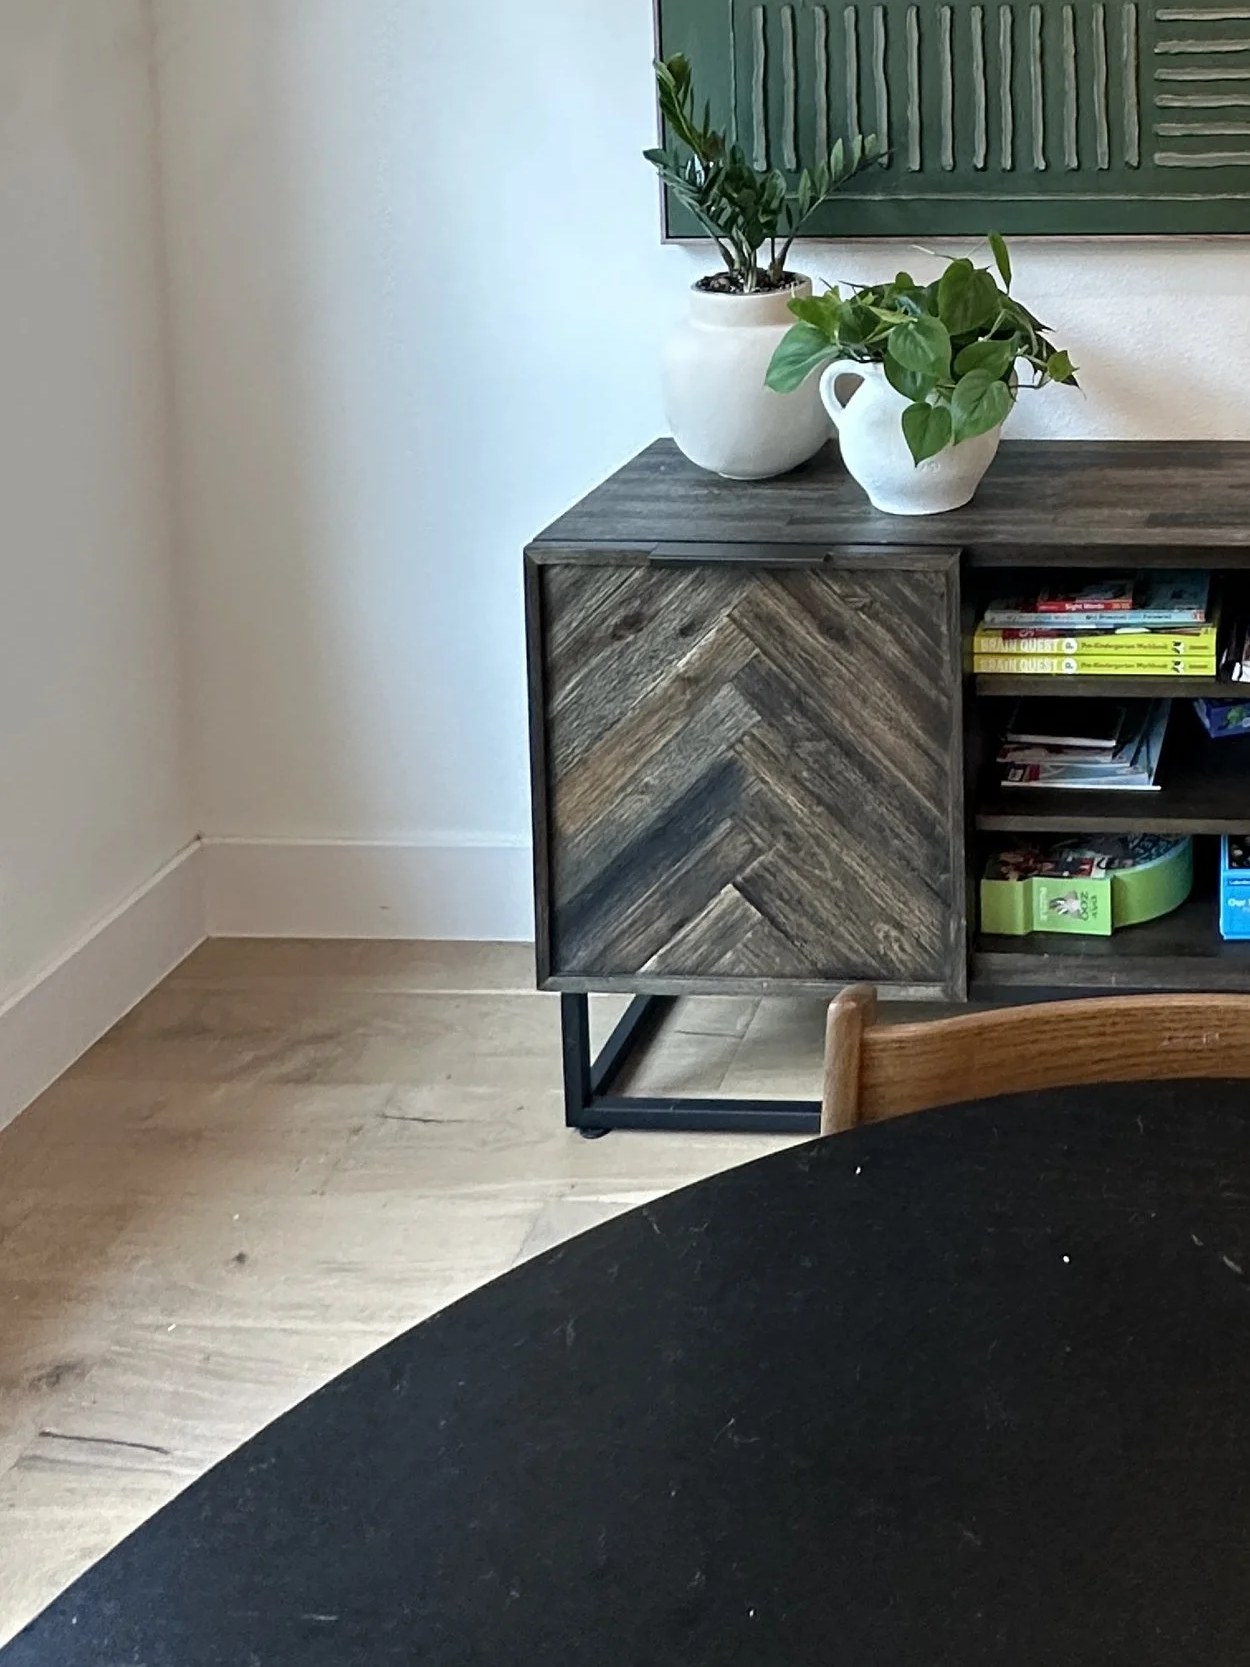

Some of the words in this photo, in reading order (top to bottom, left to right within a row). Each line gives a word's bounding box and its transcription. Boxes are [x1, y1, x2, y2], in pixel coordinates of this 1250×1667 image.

[982, 637, 1017, 653] BRAIN
[1020, 638, 1057, 653] QUEST
[982, 657, 1017, 672] BRAIN
[1020, 657, 1056, 672] QUEST
[1227, 898, 1246, 907] Our
